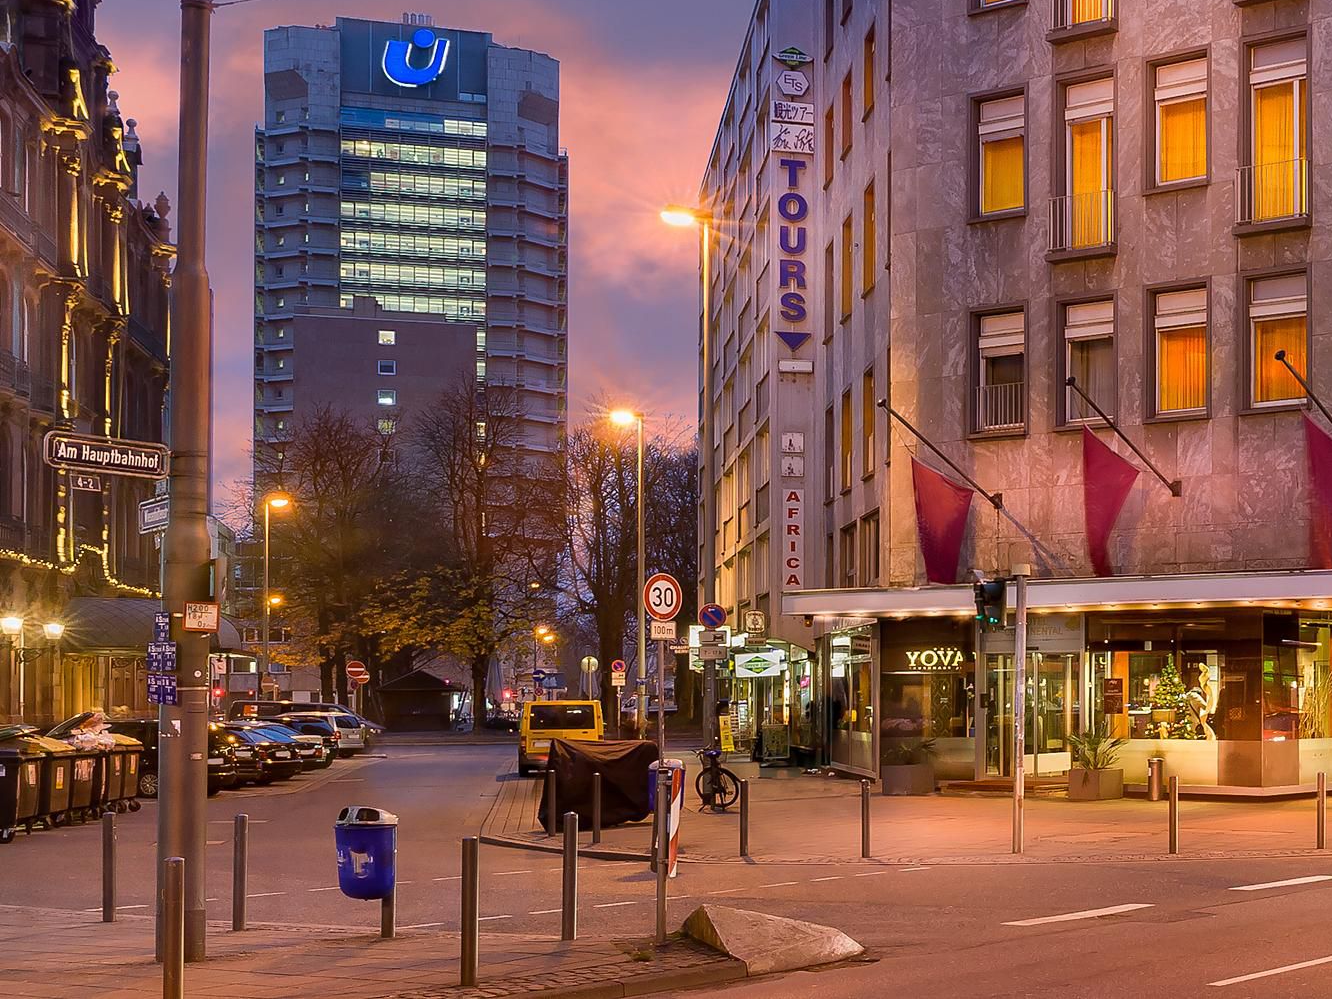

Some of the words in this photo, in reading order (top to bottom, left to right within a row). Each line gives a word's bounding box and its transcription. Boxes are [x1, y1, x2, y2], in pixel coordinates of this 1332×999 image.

[784, 74, 803, 92] ETS
[778, 159, 808, 322] TOURS
[58, 442, 77, 460] Am
[82, 445, 159, 469] Hauptbahnhof
[786, 491, 800, 585] AFRICA
[652, 587, 674, 608] 30
